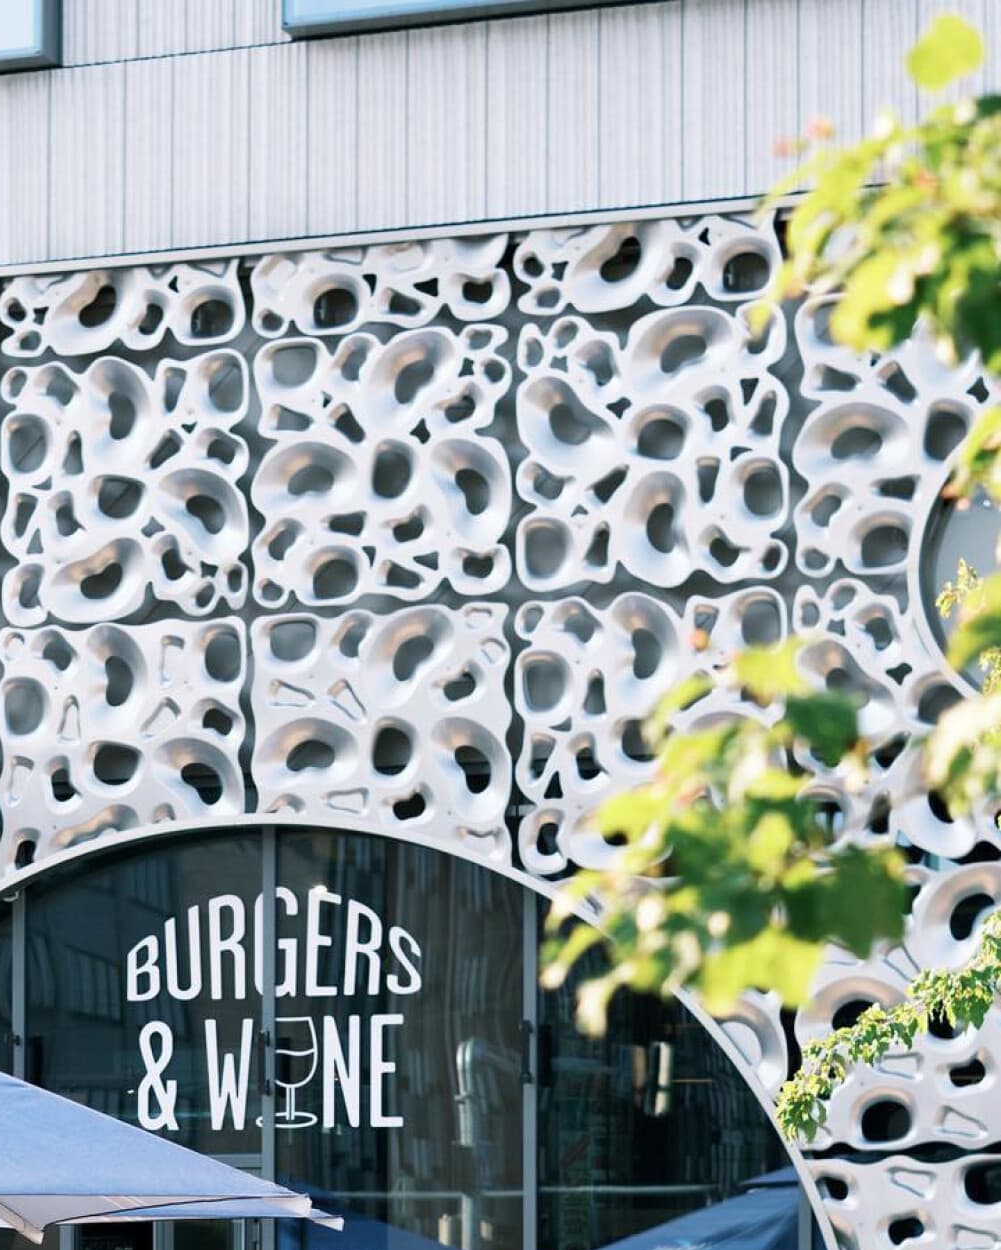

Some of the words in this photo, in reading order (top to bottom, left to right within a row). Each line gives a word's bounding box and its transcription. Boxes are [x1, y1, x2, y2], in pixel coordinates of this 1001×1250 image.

[126, 886, 422, 1001] BURGERS
[137, 1020, 179, 1131] &
[204, 1013, 404, 1131] WNE
